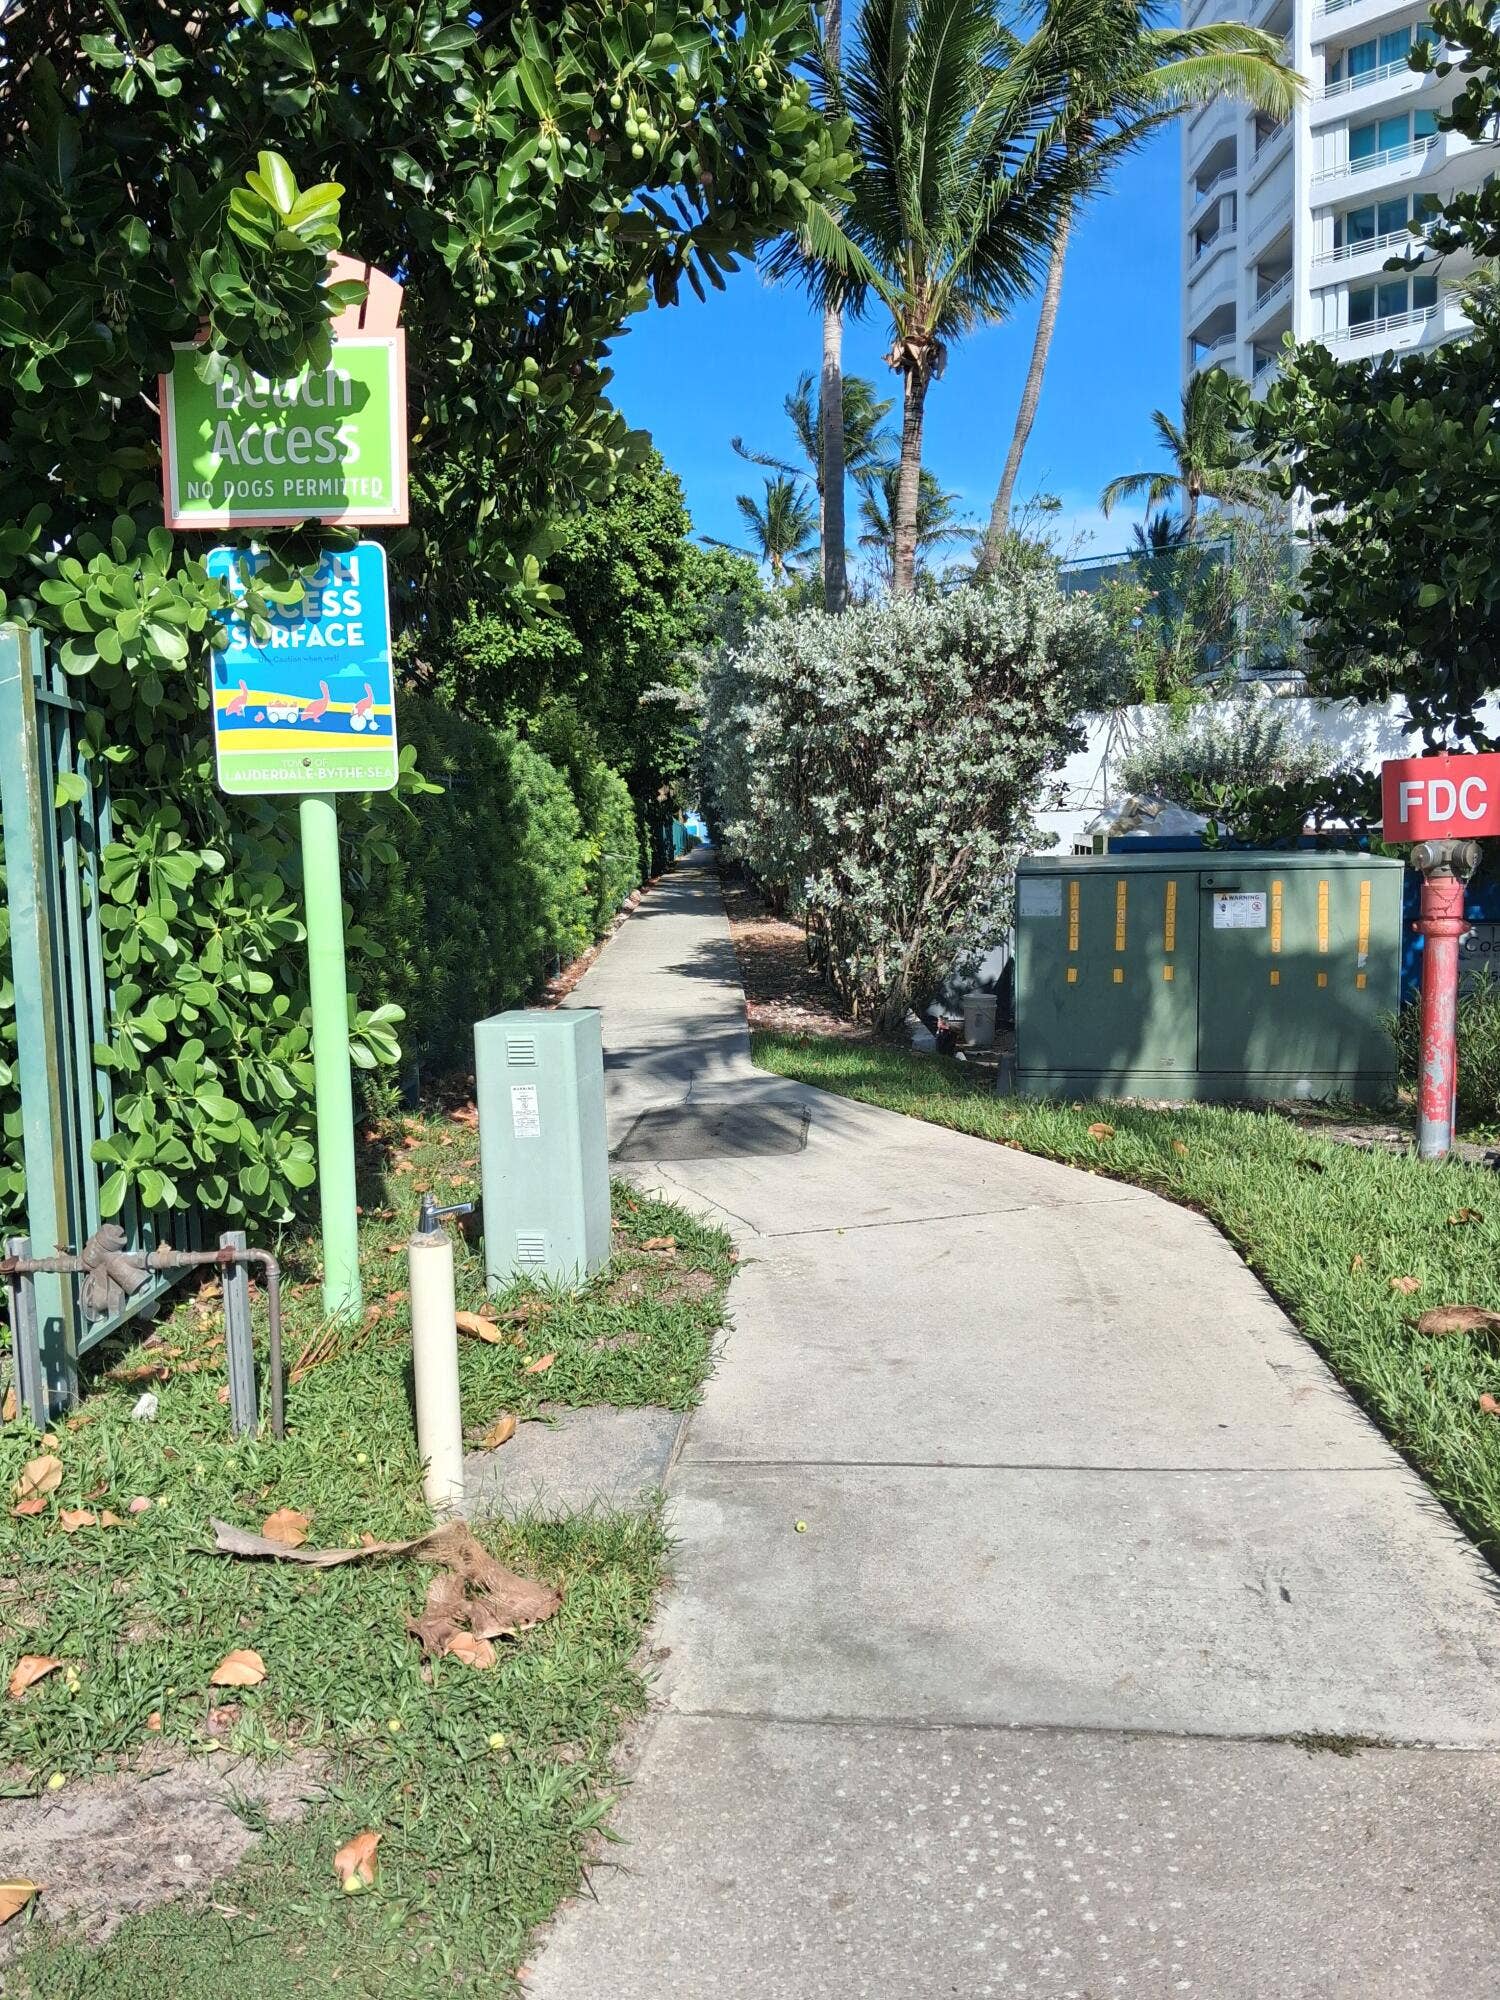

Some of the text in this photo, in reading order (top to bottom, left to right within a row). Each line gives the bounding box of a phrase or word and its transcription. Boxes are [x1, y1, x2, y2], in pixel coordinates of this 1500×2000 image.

[212, 420, 361, 466] Access
[187, 477, 384, 499] NO DOGS PERMITTED
[229, 556, 360, 590] BCH
[231, 589, 362, 620] CESS
[281, 759, 311, 768] TOW
[1399, 776, 1488, 823] FDC
